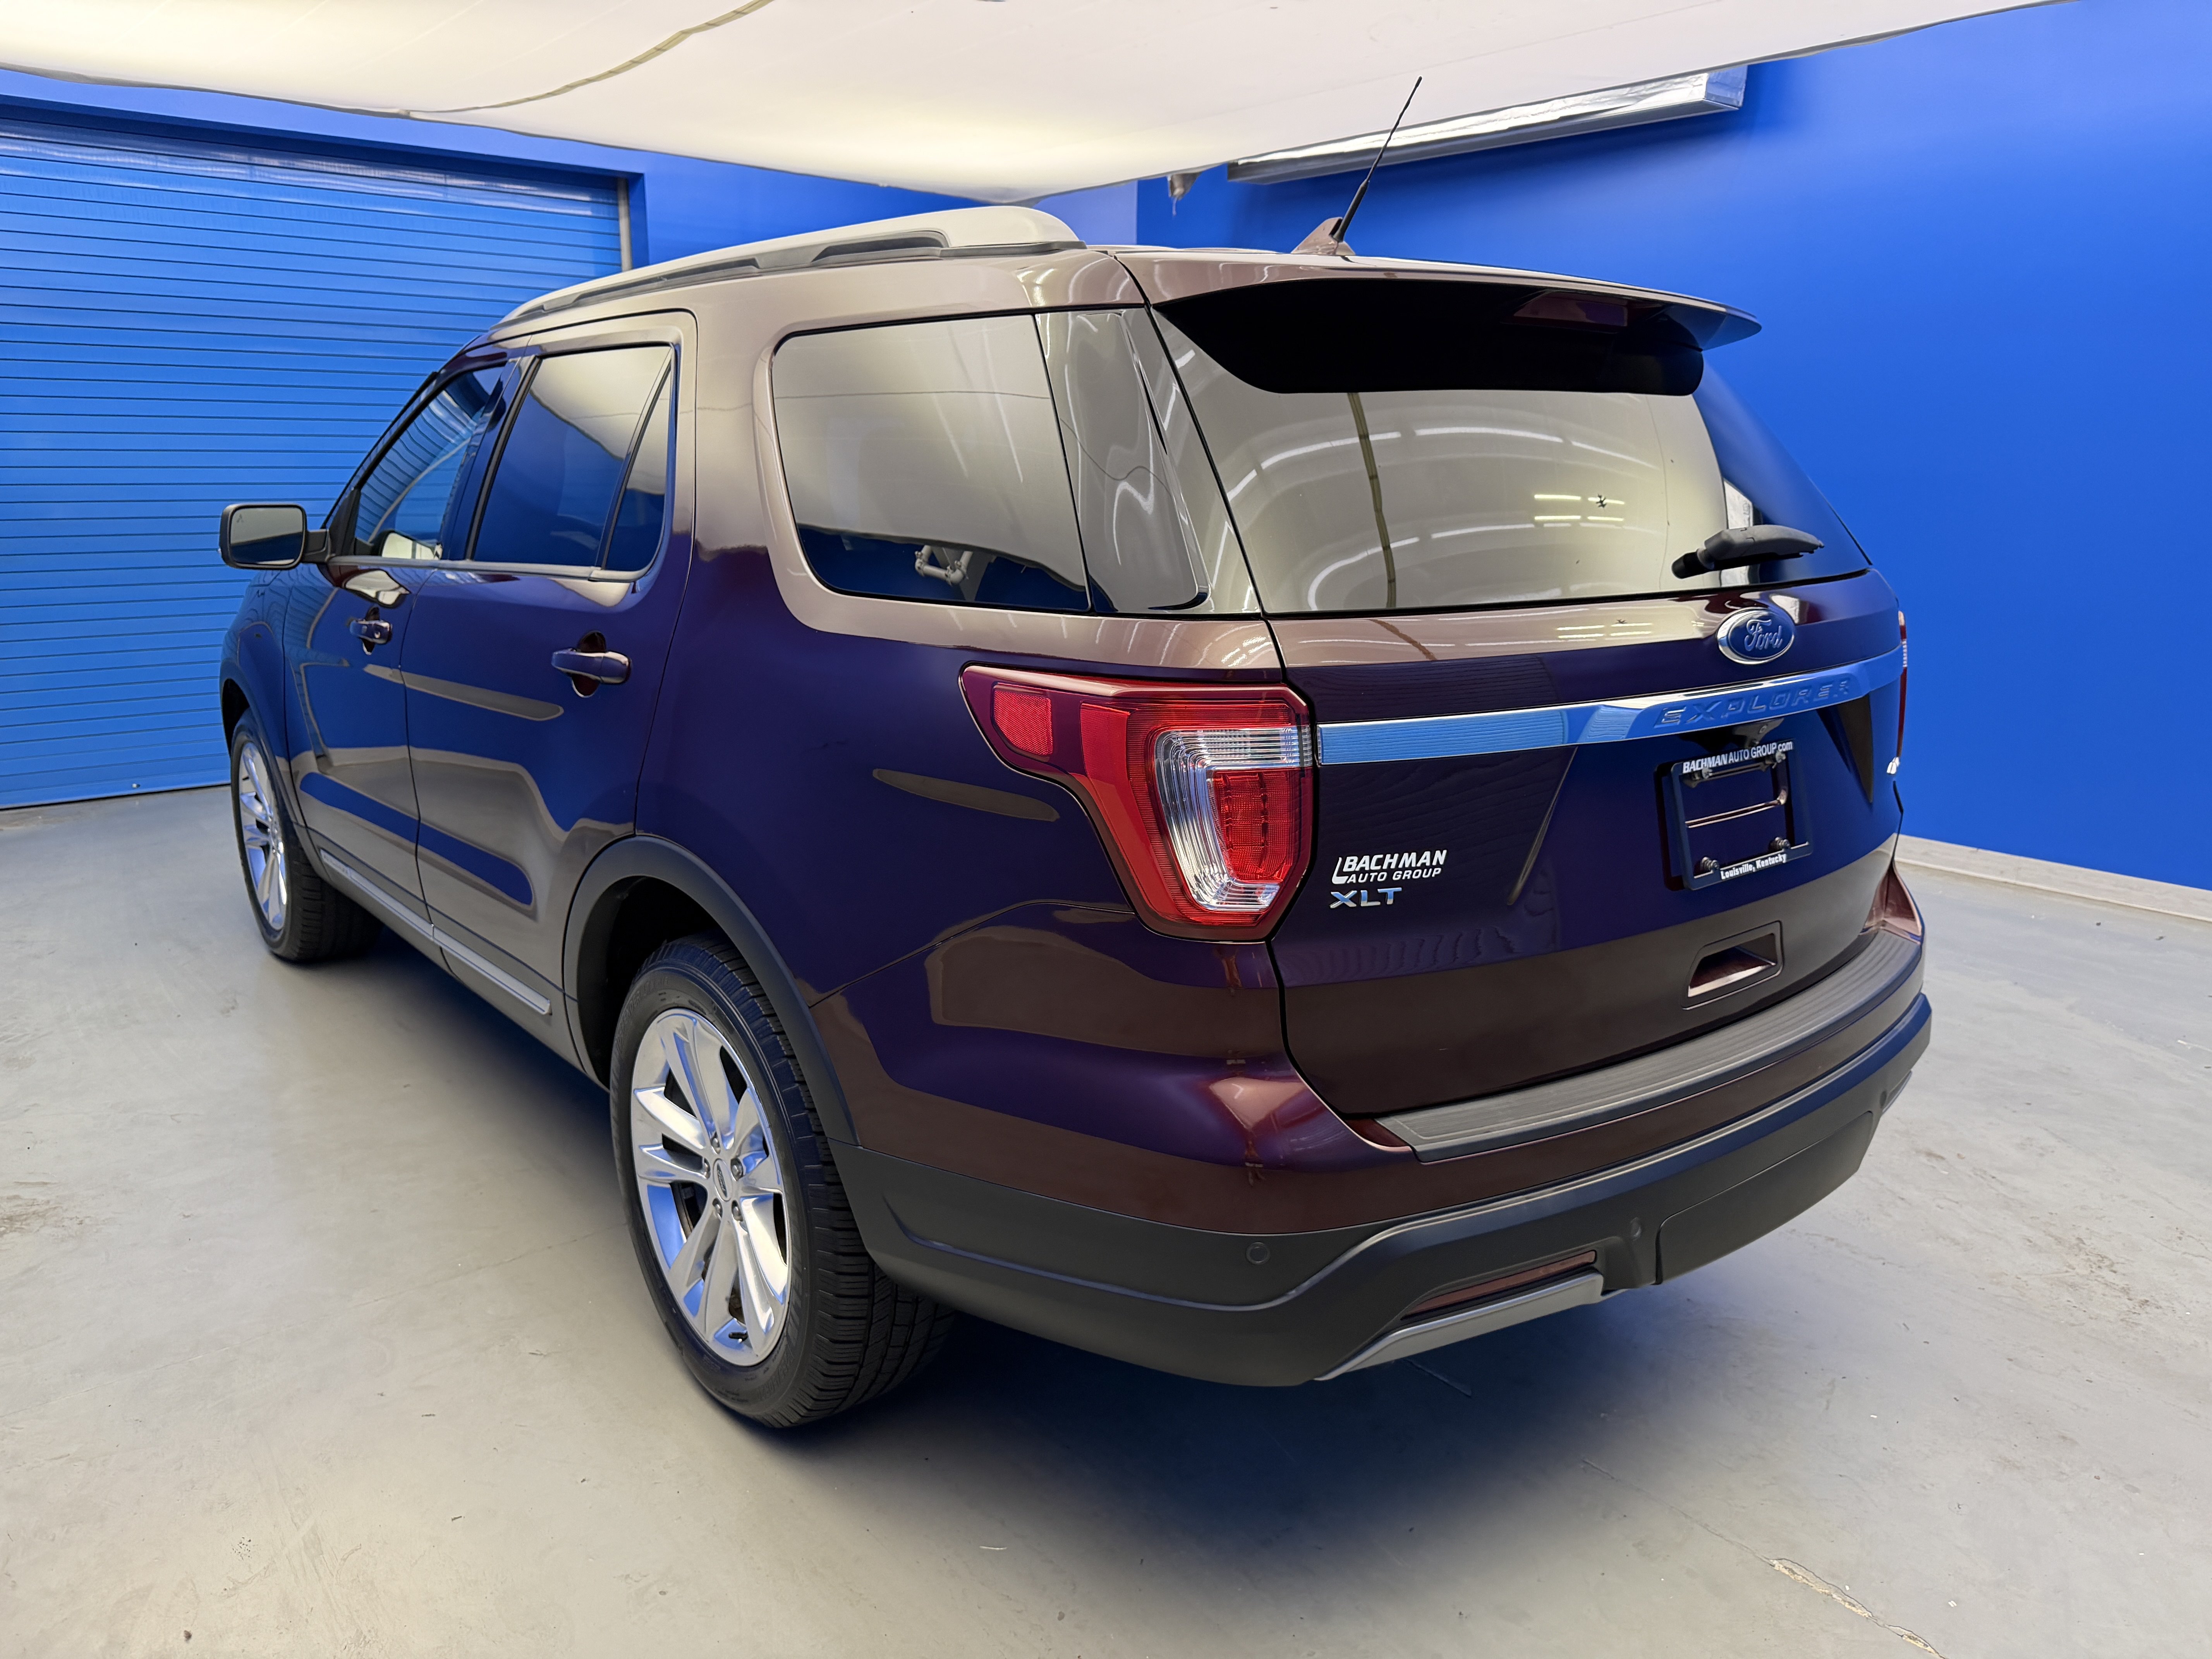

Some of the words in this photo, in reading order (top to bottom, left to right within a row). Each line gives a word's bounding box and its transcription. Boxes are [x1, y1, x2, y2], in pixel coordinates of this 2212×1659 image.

[1744, 619, 1783, 651] Ford
[1654, 680, 1849, 728] EXPLORER
[1683, 754, 1728, 774] BACHMAN
[1728, 749, 1750, 764] AUTO
[1343, 850, 1447, 872] BACHMAN
[1721, 863, 1755, 880] Louisville,
[1756, 853, 1786, 869] Kentucky
[1347, 872, 1386, 883] AUTO
[1393, 867, 1441, 880] GROUP
[1330, 887, 1402, 908] XLT
